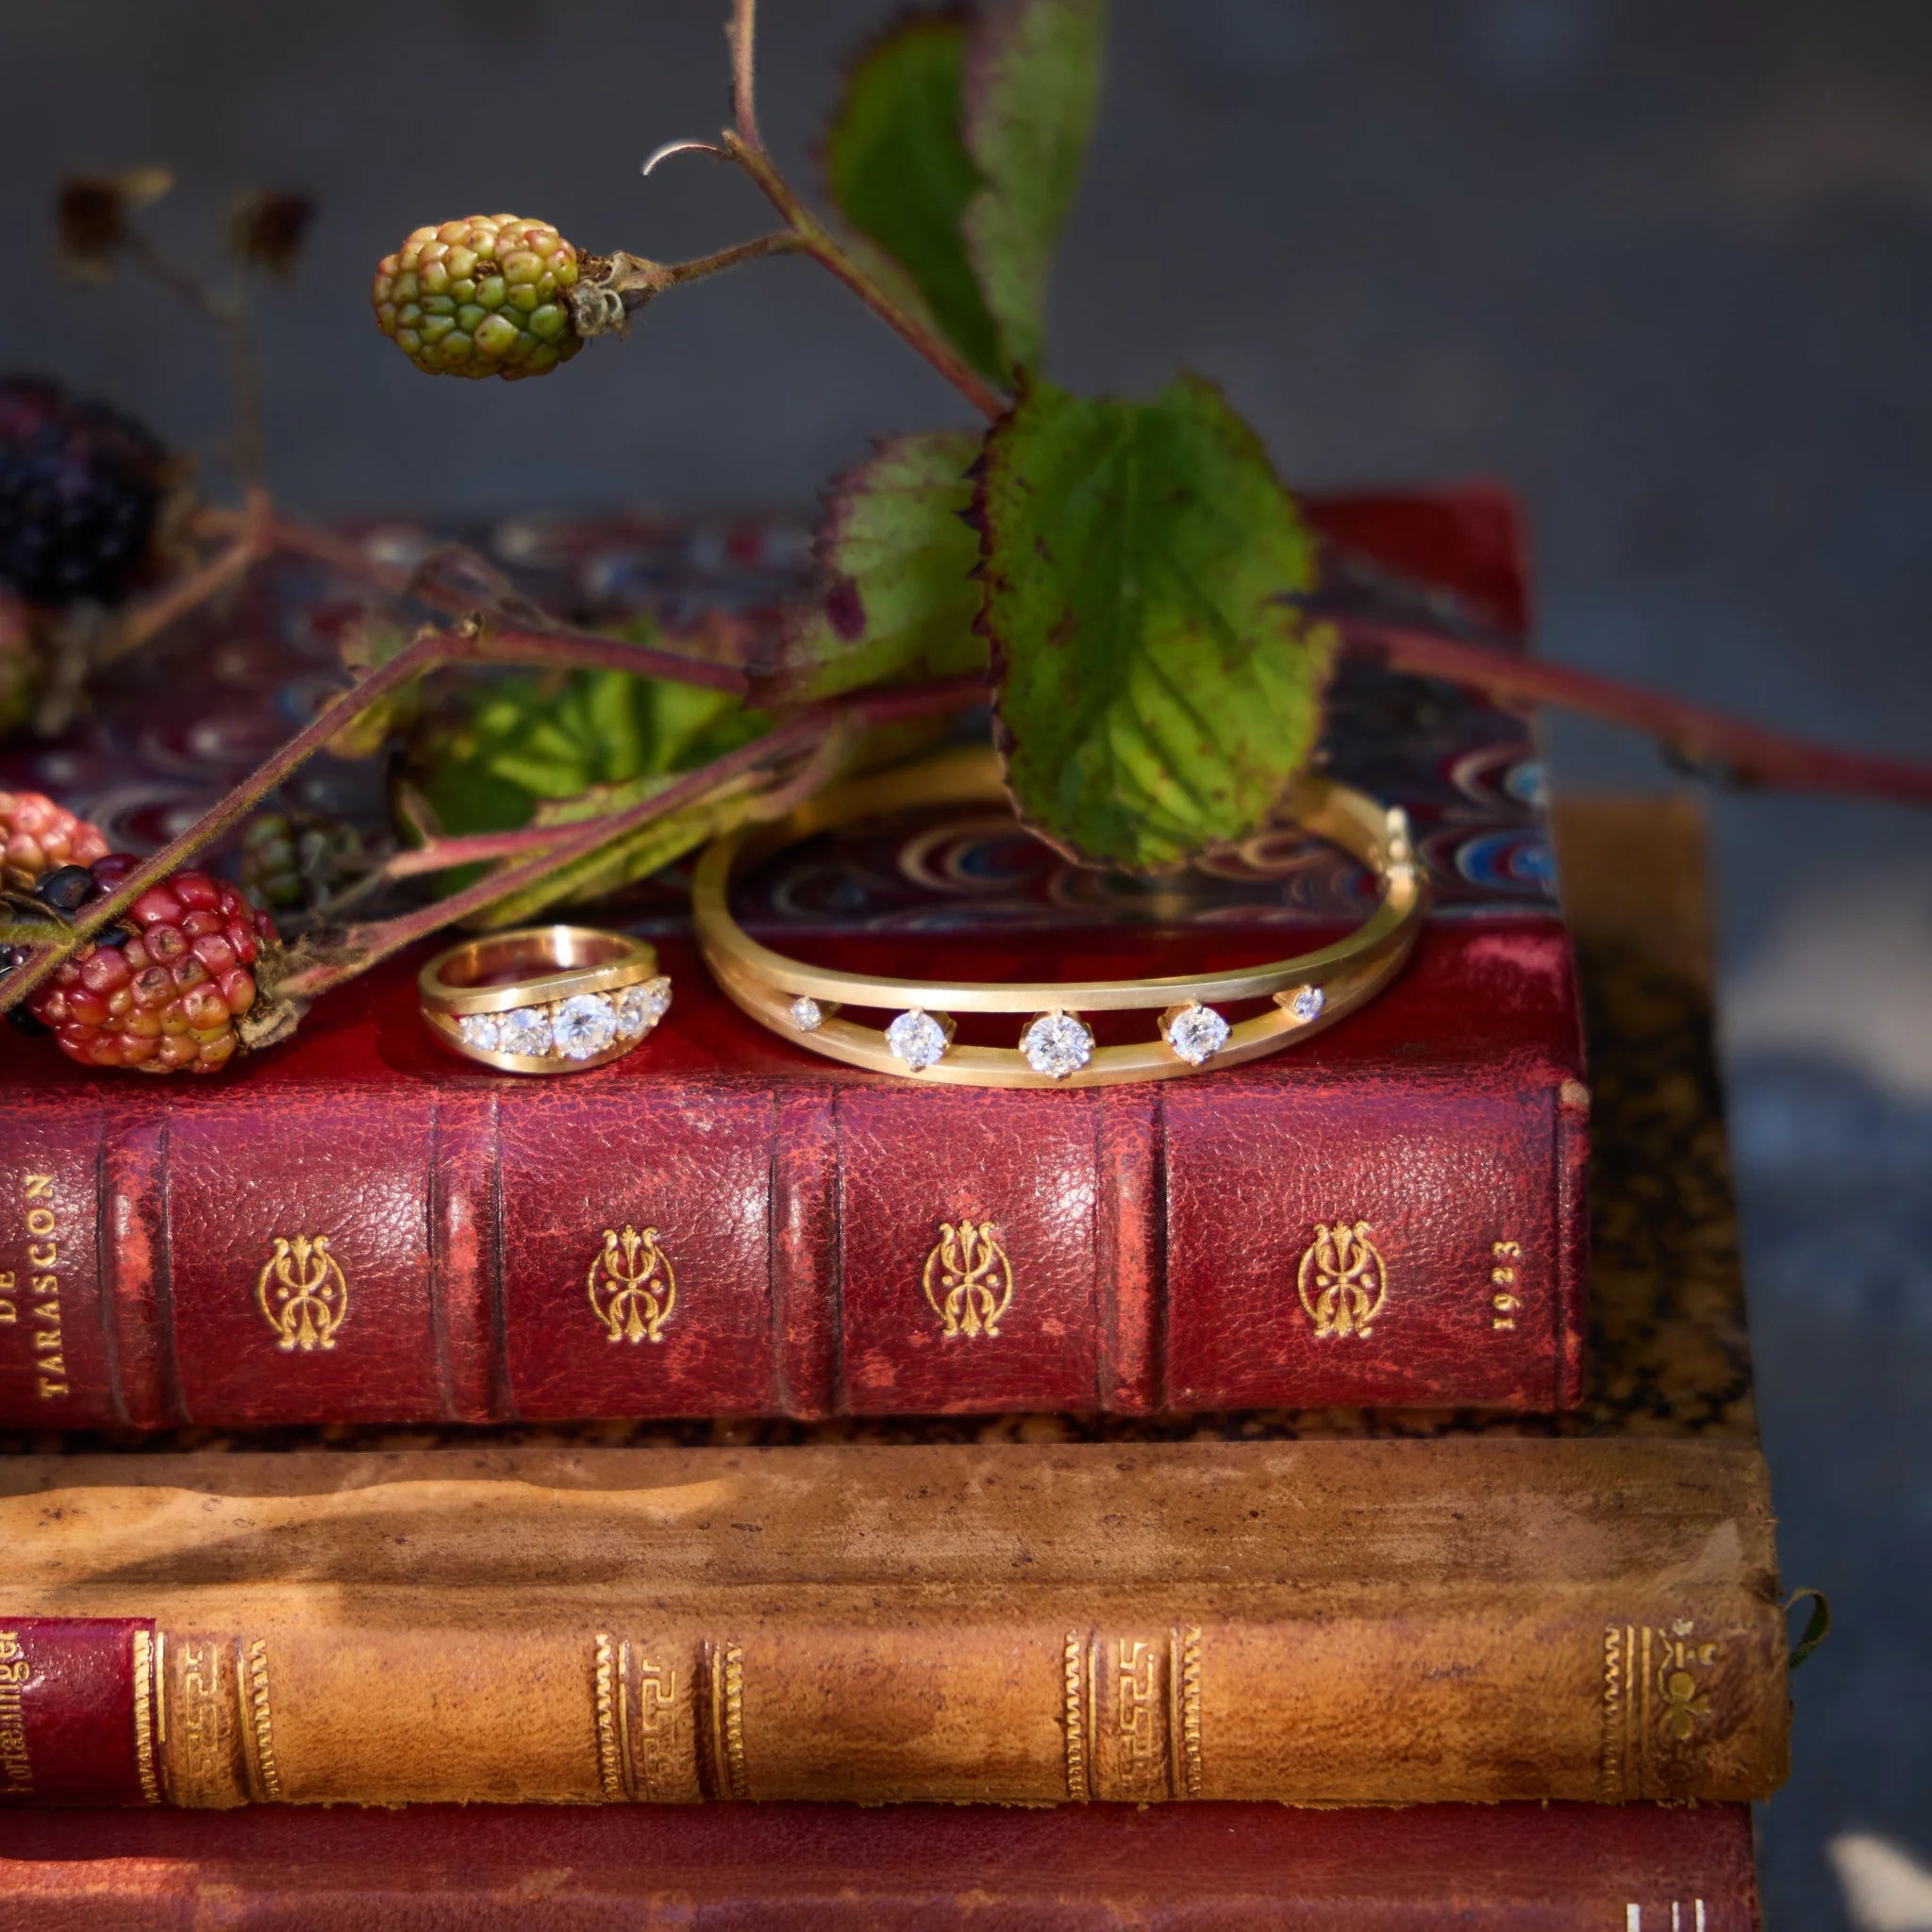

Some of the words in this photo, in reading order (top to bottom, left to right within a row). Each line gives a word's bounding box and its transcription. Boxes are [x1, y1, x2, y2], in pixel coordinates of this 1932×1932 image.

[0, 1272, 16, 1323] DE
[24, 1175, 68, 1398] TARASCON
[1492, 1241, 1520, 1329] 1923
